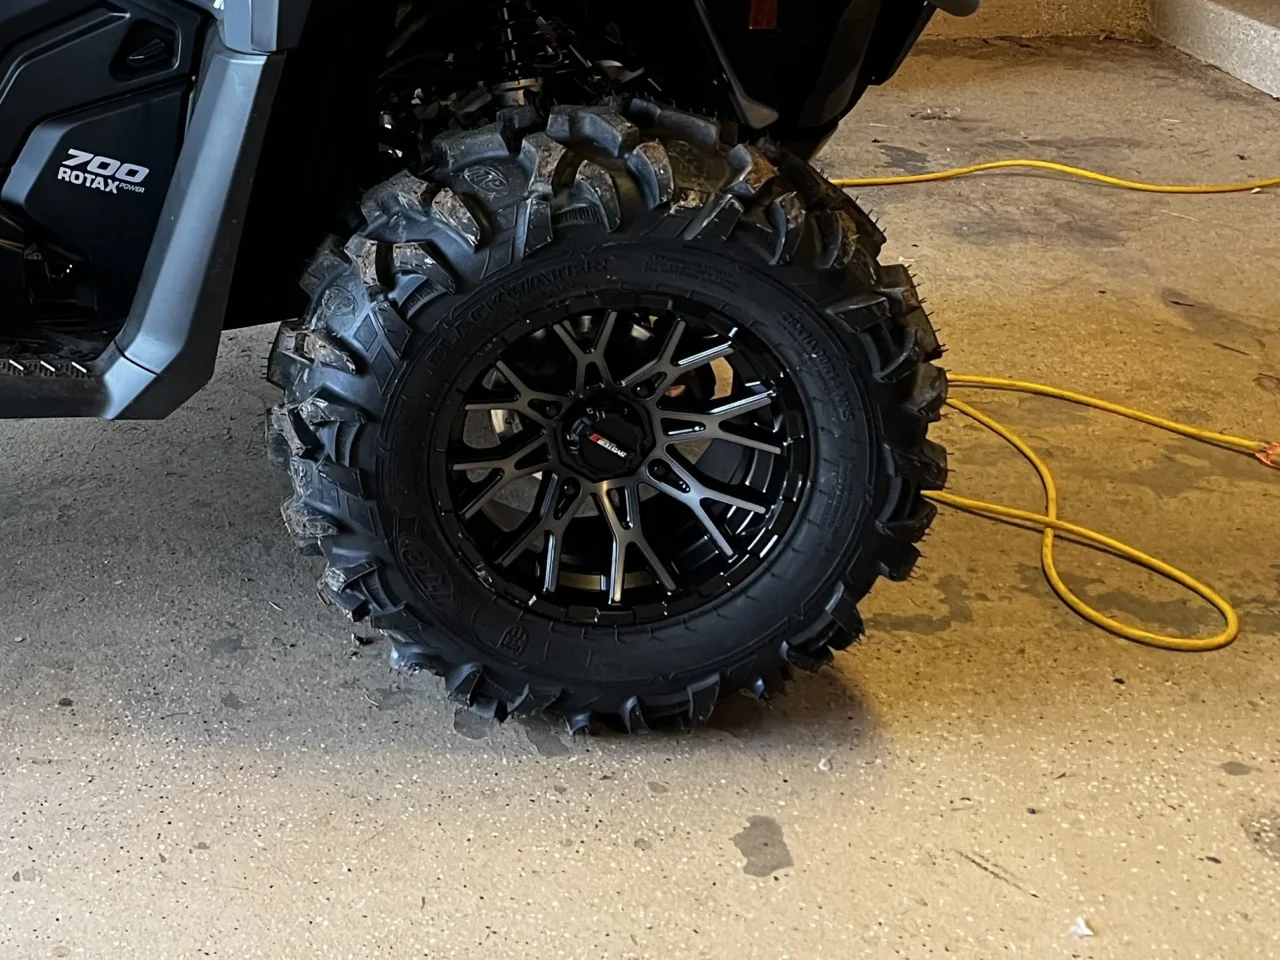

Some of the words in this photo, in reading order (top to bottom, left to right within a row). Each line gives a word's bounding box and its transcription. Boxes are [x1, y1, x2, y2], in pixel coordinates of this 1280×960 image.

[57, 166, 120, 194] ROTAX
[119, 182, 145, 194] POWER
[61, 148, 150, 183] 700
